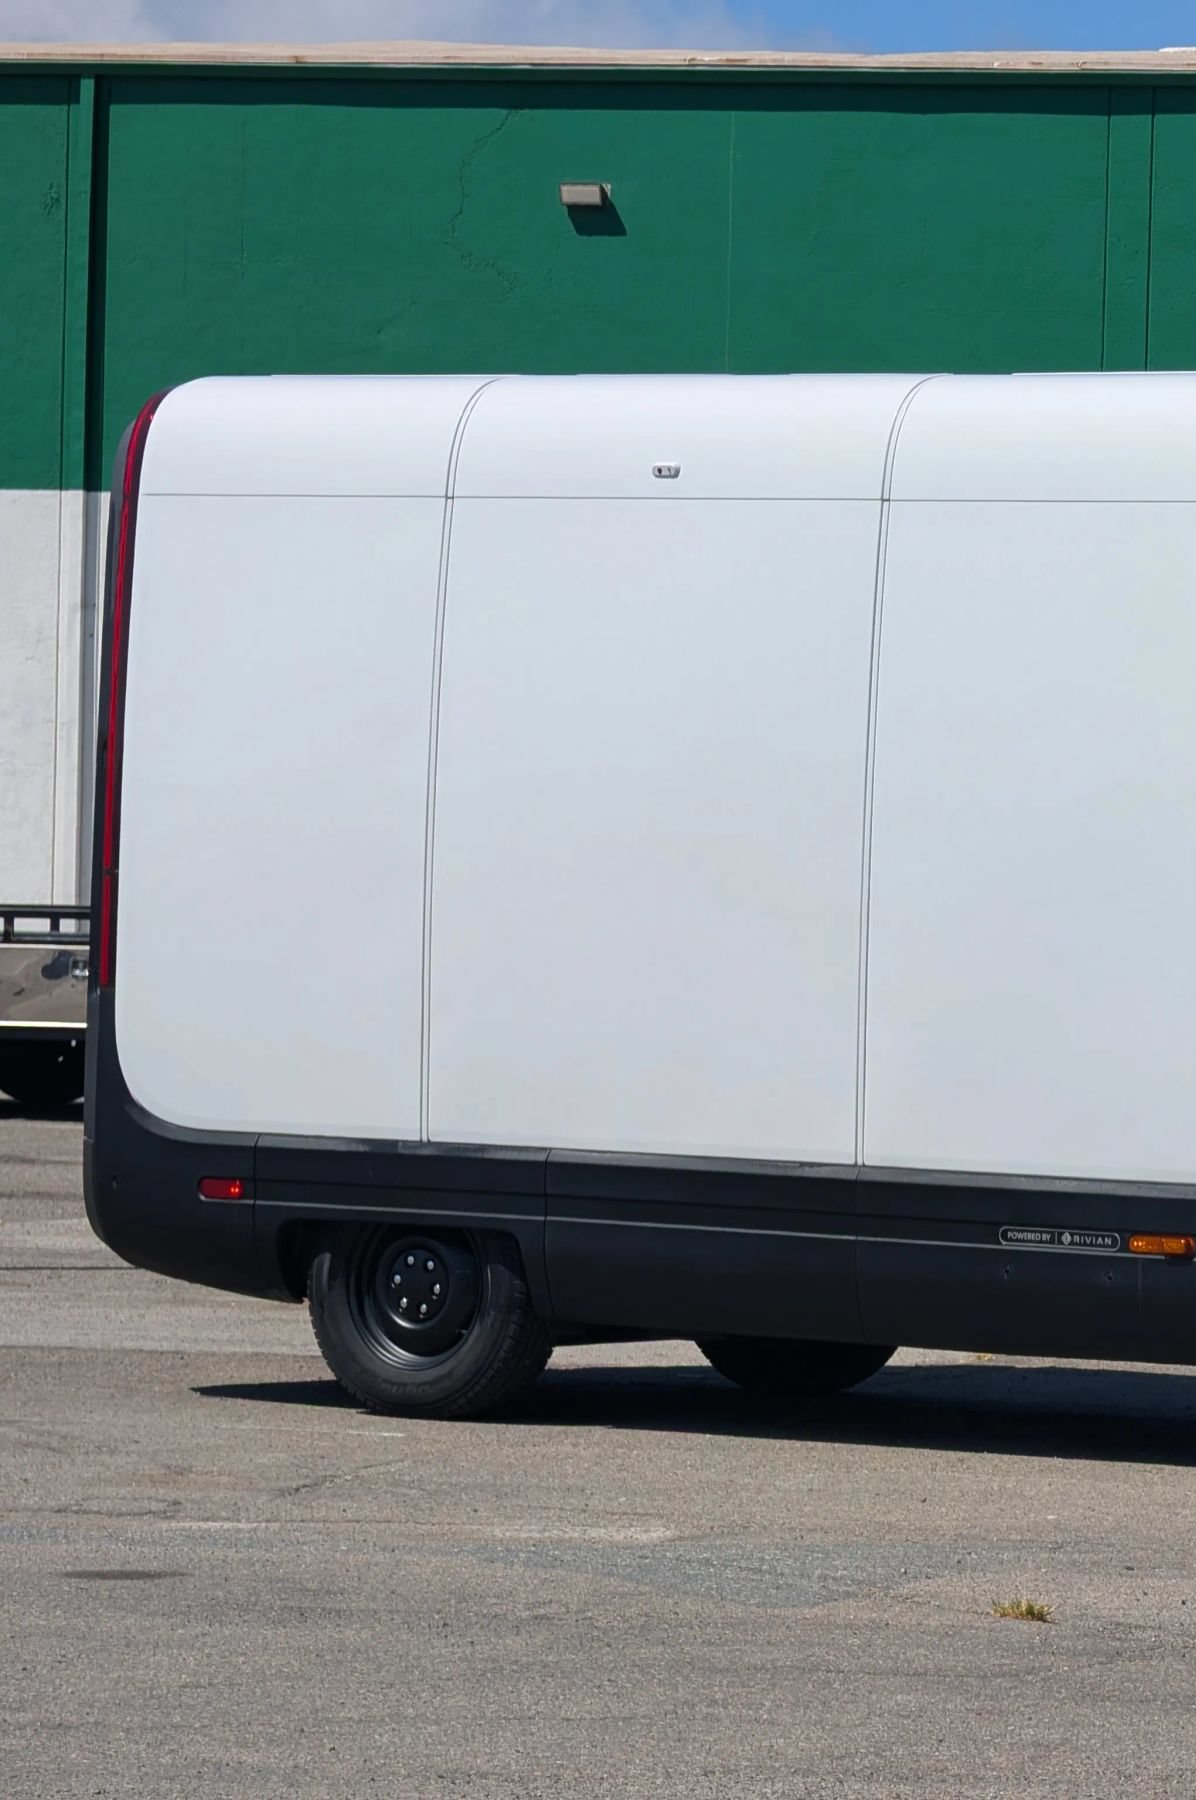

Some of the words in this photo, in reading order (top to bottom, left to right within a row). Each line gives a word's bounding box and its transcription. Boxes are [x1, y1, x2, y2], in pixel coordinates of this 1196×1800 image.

[1007, 1231, 1041, 1241] POWERED
[1041, 1233, 1052, 1242] BY
[1073, 1235, 1113, 1246] RIVIAN
